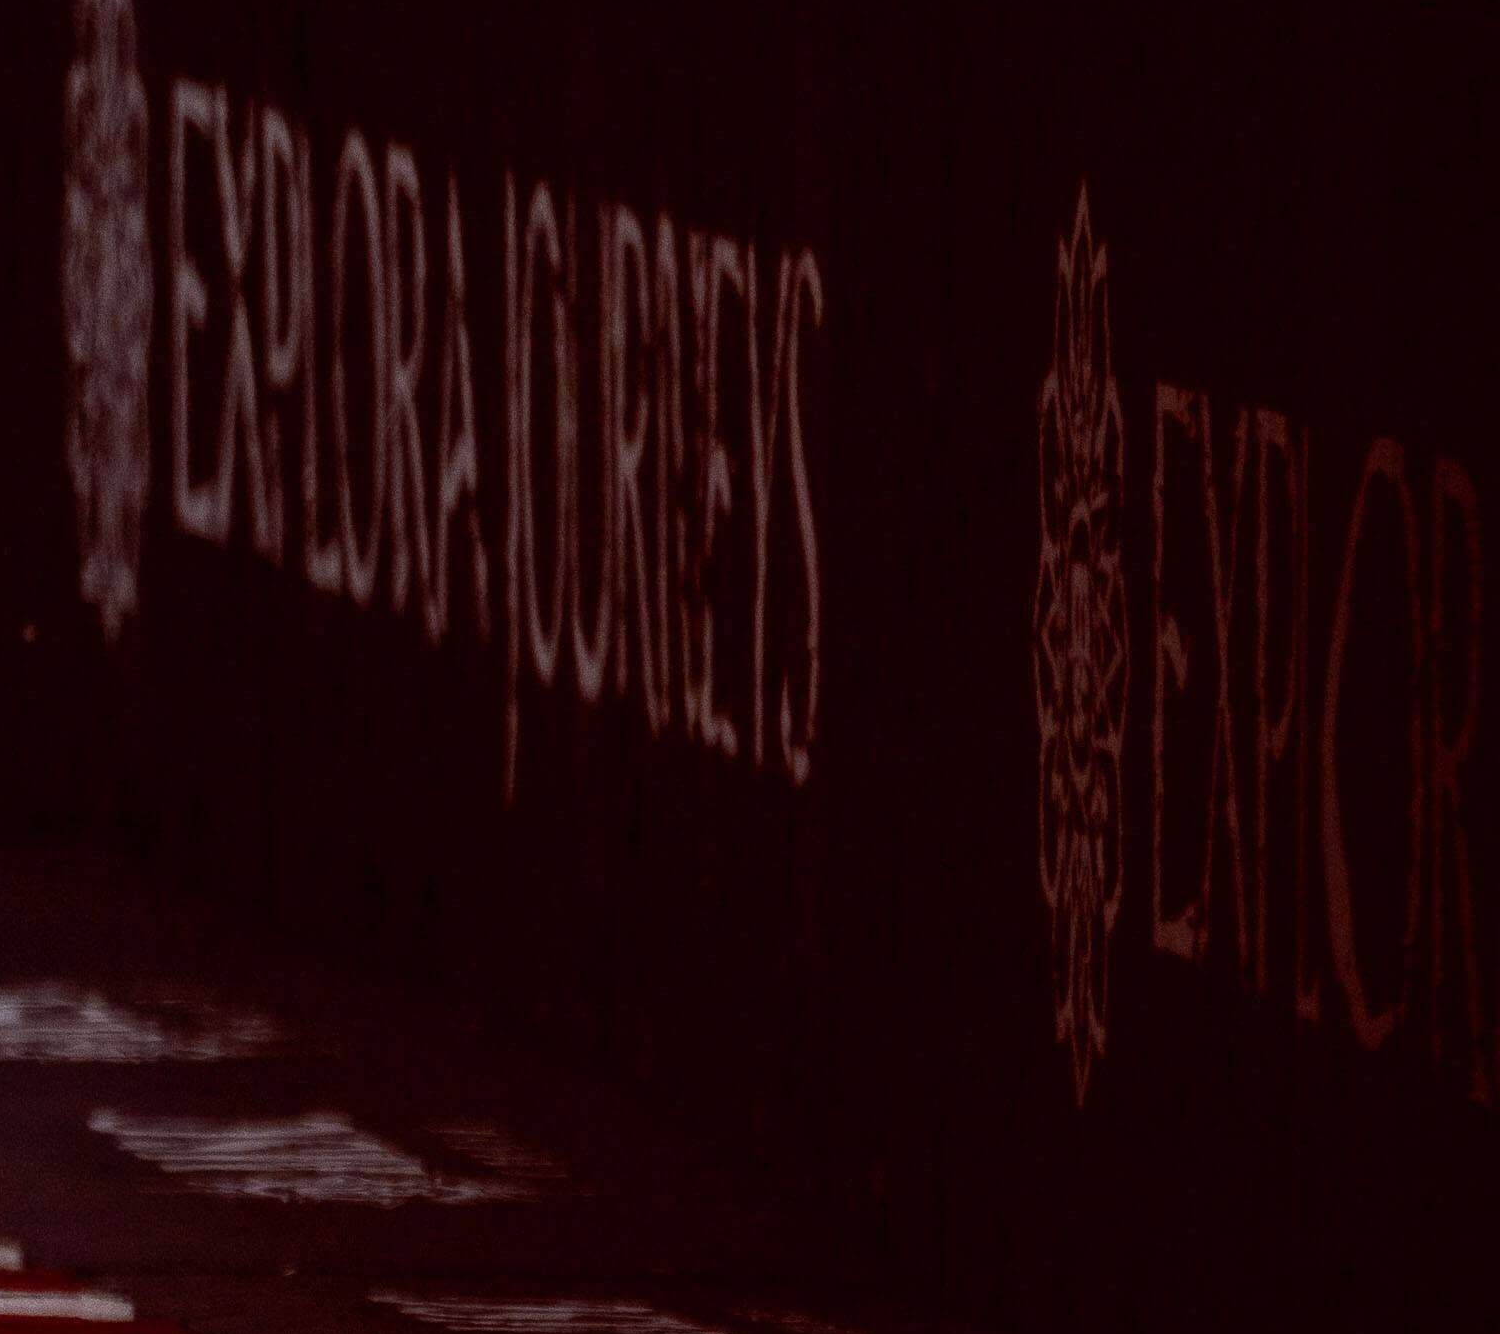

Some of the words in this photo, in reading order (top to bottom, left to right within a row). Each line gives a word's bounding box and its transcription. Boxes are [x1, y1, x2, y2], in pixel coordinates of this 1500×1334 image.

[168, 75, 492, 645] EXPLORA
[504, 167, 824, 807] JOURNEYS
[1152, 377, 1499, 1107] EXPLOR
